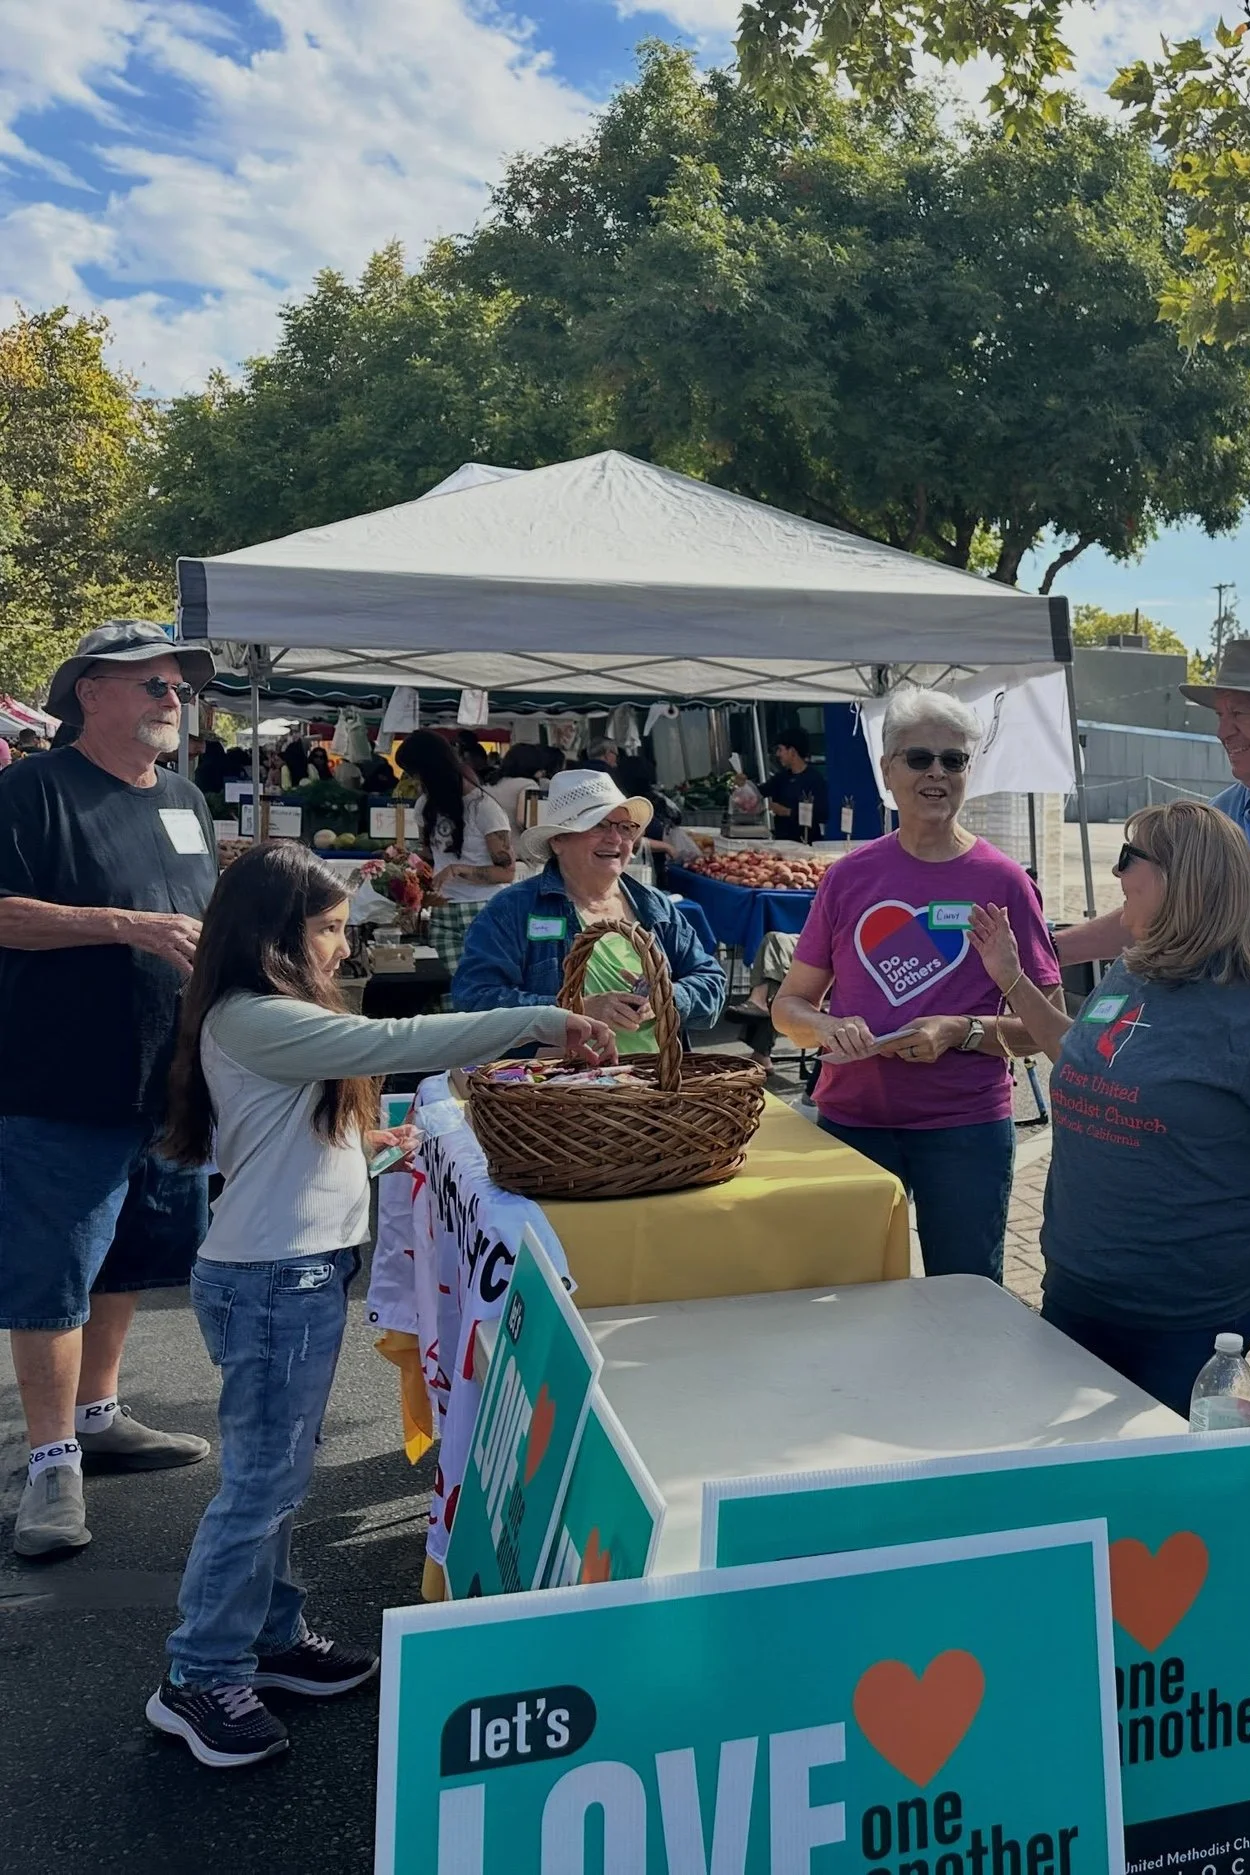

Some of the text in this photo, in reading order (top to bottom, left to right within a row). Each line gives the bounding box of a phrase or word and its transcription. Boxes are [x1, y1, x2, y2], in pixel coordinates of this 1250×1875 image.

[879, 956, 901, 974] Do
[887, 957, 920, 983] Unto
[894, 958, 942, 992] Others
[1059, 1063, 1140, 1104] First United
[1104, 1105, 1168, 1134] Church
[861, 1791, 963, 1861] one
[1166, 1841, 1231, 1866] Methodist
